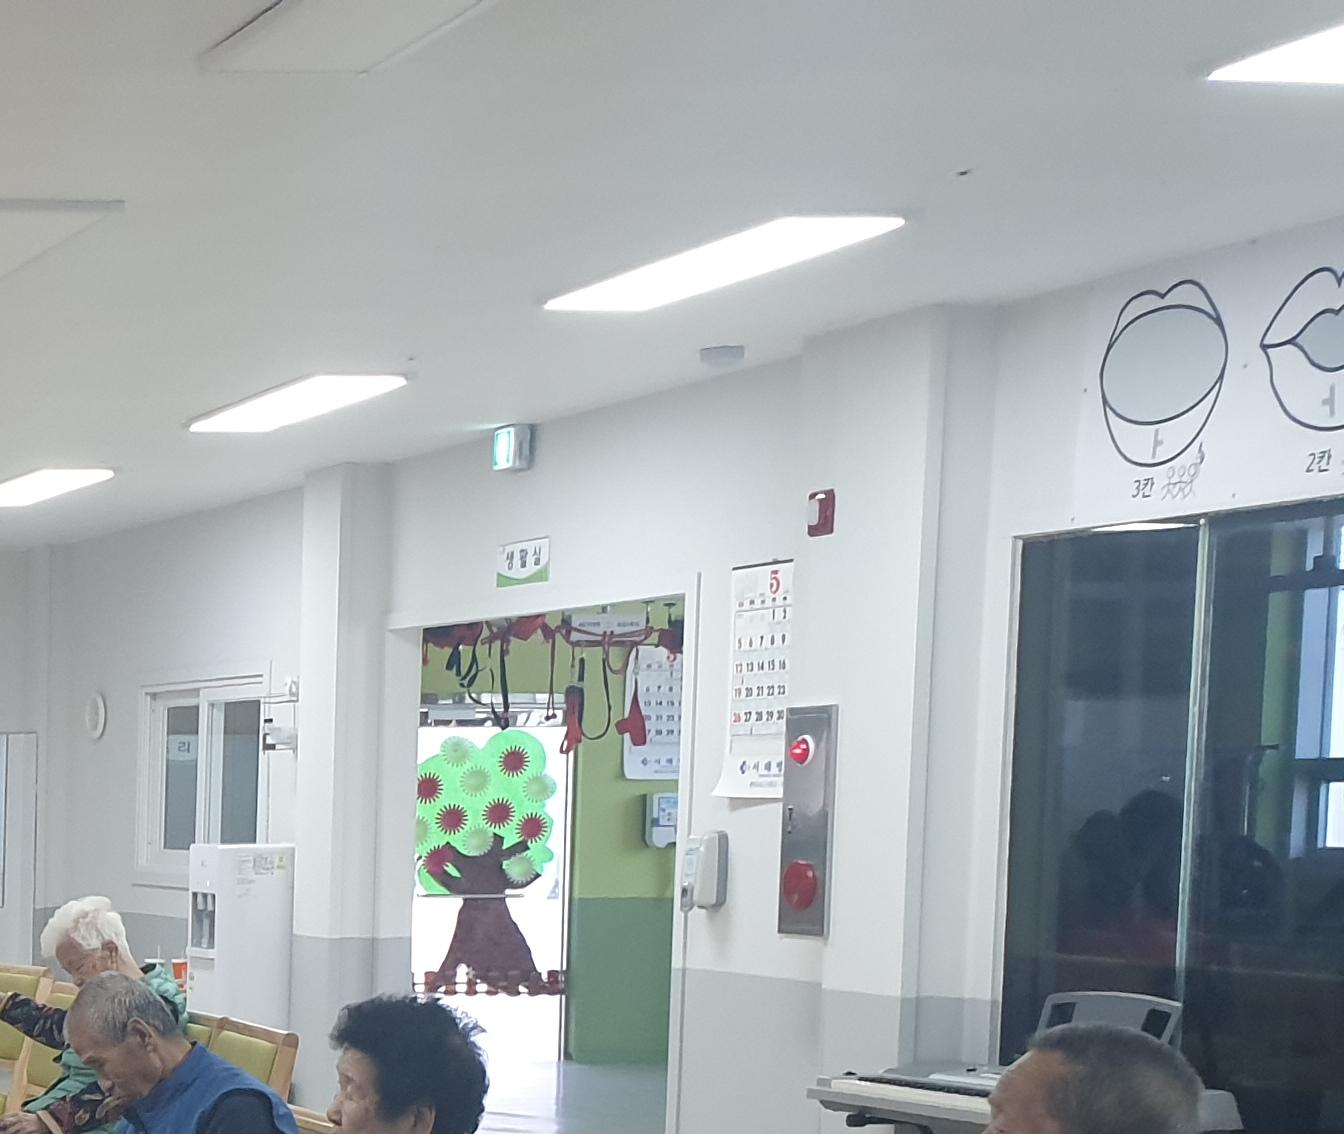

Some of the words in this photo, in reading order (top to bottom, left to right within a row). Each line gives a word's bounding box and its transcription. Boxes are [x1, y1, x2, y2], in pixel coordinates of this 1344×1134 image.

[1305, 448, 1332, 473] 2칸
[1131, 477, 1155, 498] 3칸
[506, 545, 542, 571] 생활실
[769, 569, 781, 595] 5
